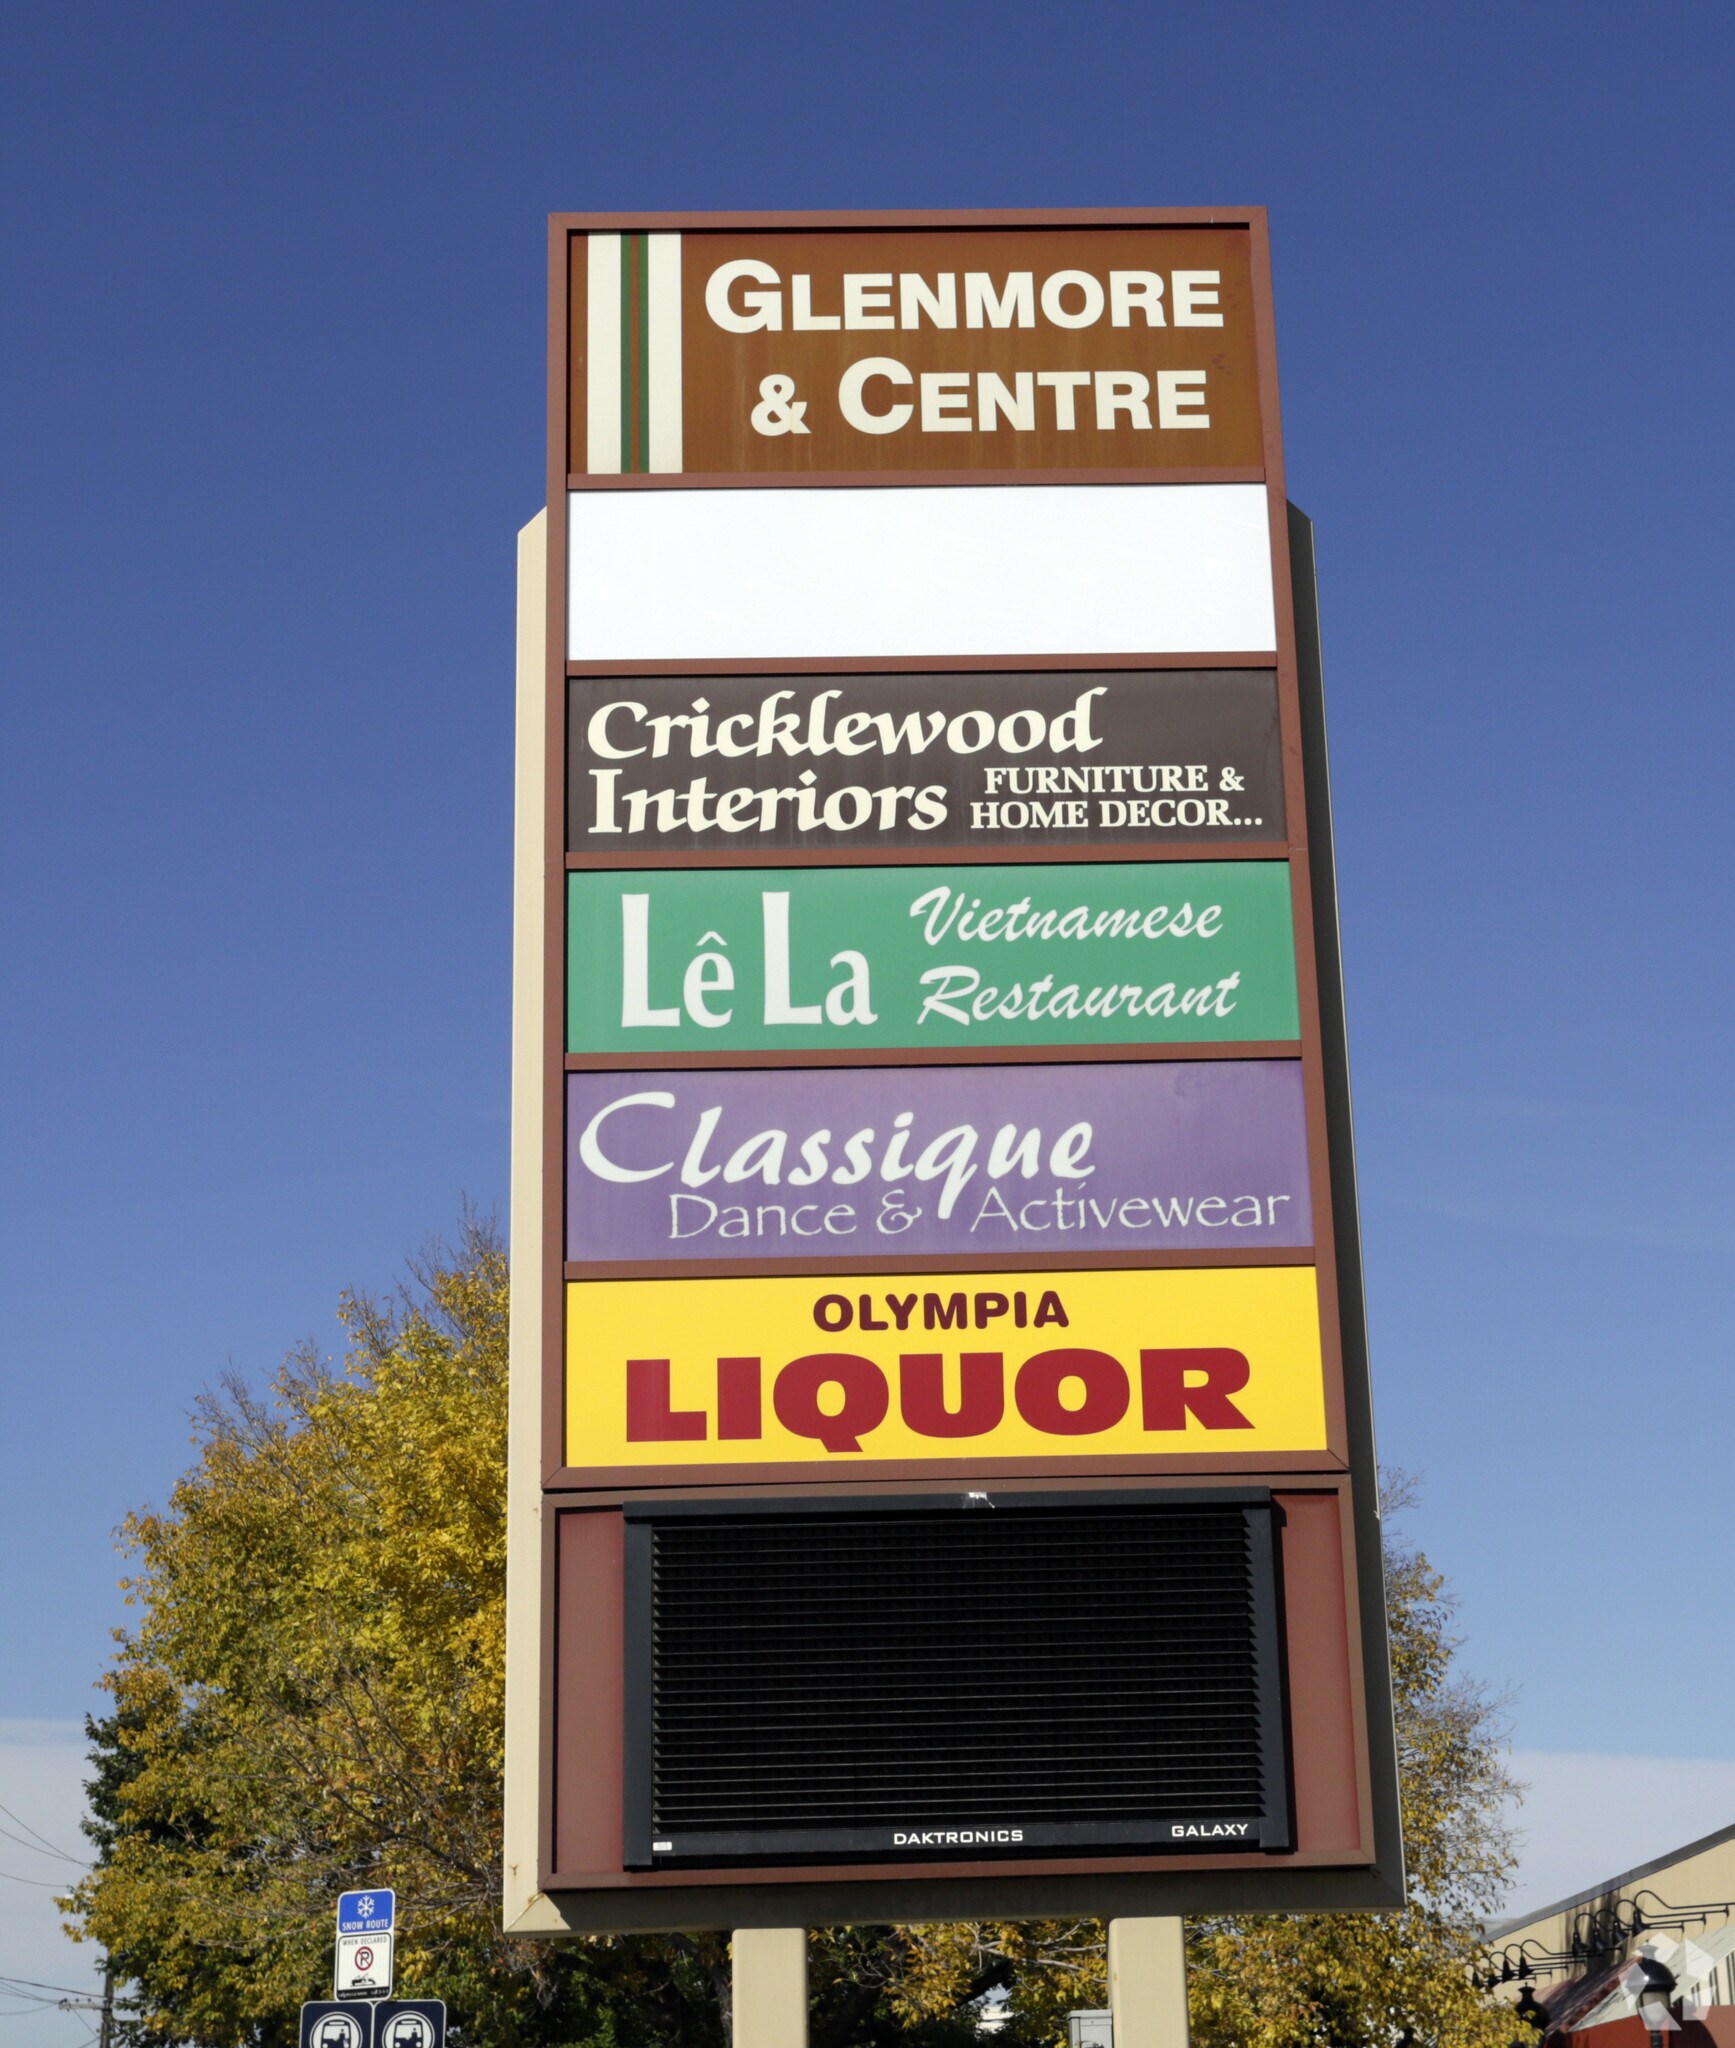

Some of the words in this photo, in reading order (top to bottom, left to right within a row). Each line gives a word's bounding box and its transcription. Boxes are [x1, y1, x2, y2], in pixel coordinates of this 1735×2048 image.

[705, 260, 1224, 334] GLENMORE
[751, 374, 811, 437] &
[839, 357, 1211, 435] CENTRE
[588, 687, 1108, 760] Cricklewood
[588, 769, 948, 834] Interiors
[984, 765, 1209, 795] FURNITURE
[1219, 766, 1245, 792] &
[970, 801, 1089, 829] HOME
[1099, 799, 1263, 828] DECOR...
[910, 886, 1223, 945] Vietnamese
[622, 894, 735, 1028] Lê
[762, 892, 879, 1026] La
[917, 966, 1240, 1026] Restaurant
[579, 1091, 1096, 1220] Classique
[669, 1193, 857, 1239] Dance
[876, 1189, 923, 1235] &
[970, 1182, 1291, 1233] Activewear
[813, 1291, 1070, 1333] OLYMPIA
[626, 1347, 1257, 1453] LIQUOR
[894, 1829, 1024, 1845] DAKTRONICS
[1172, 1823, 1249, 1838] GALAXY
[342, 1921, 363, 1931] SNOW
[366, 1919, 389, 1929] ROUTE
